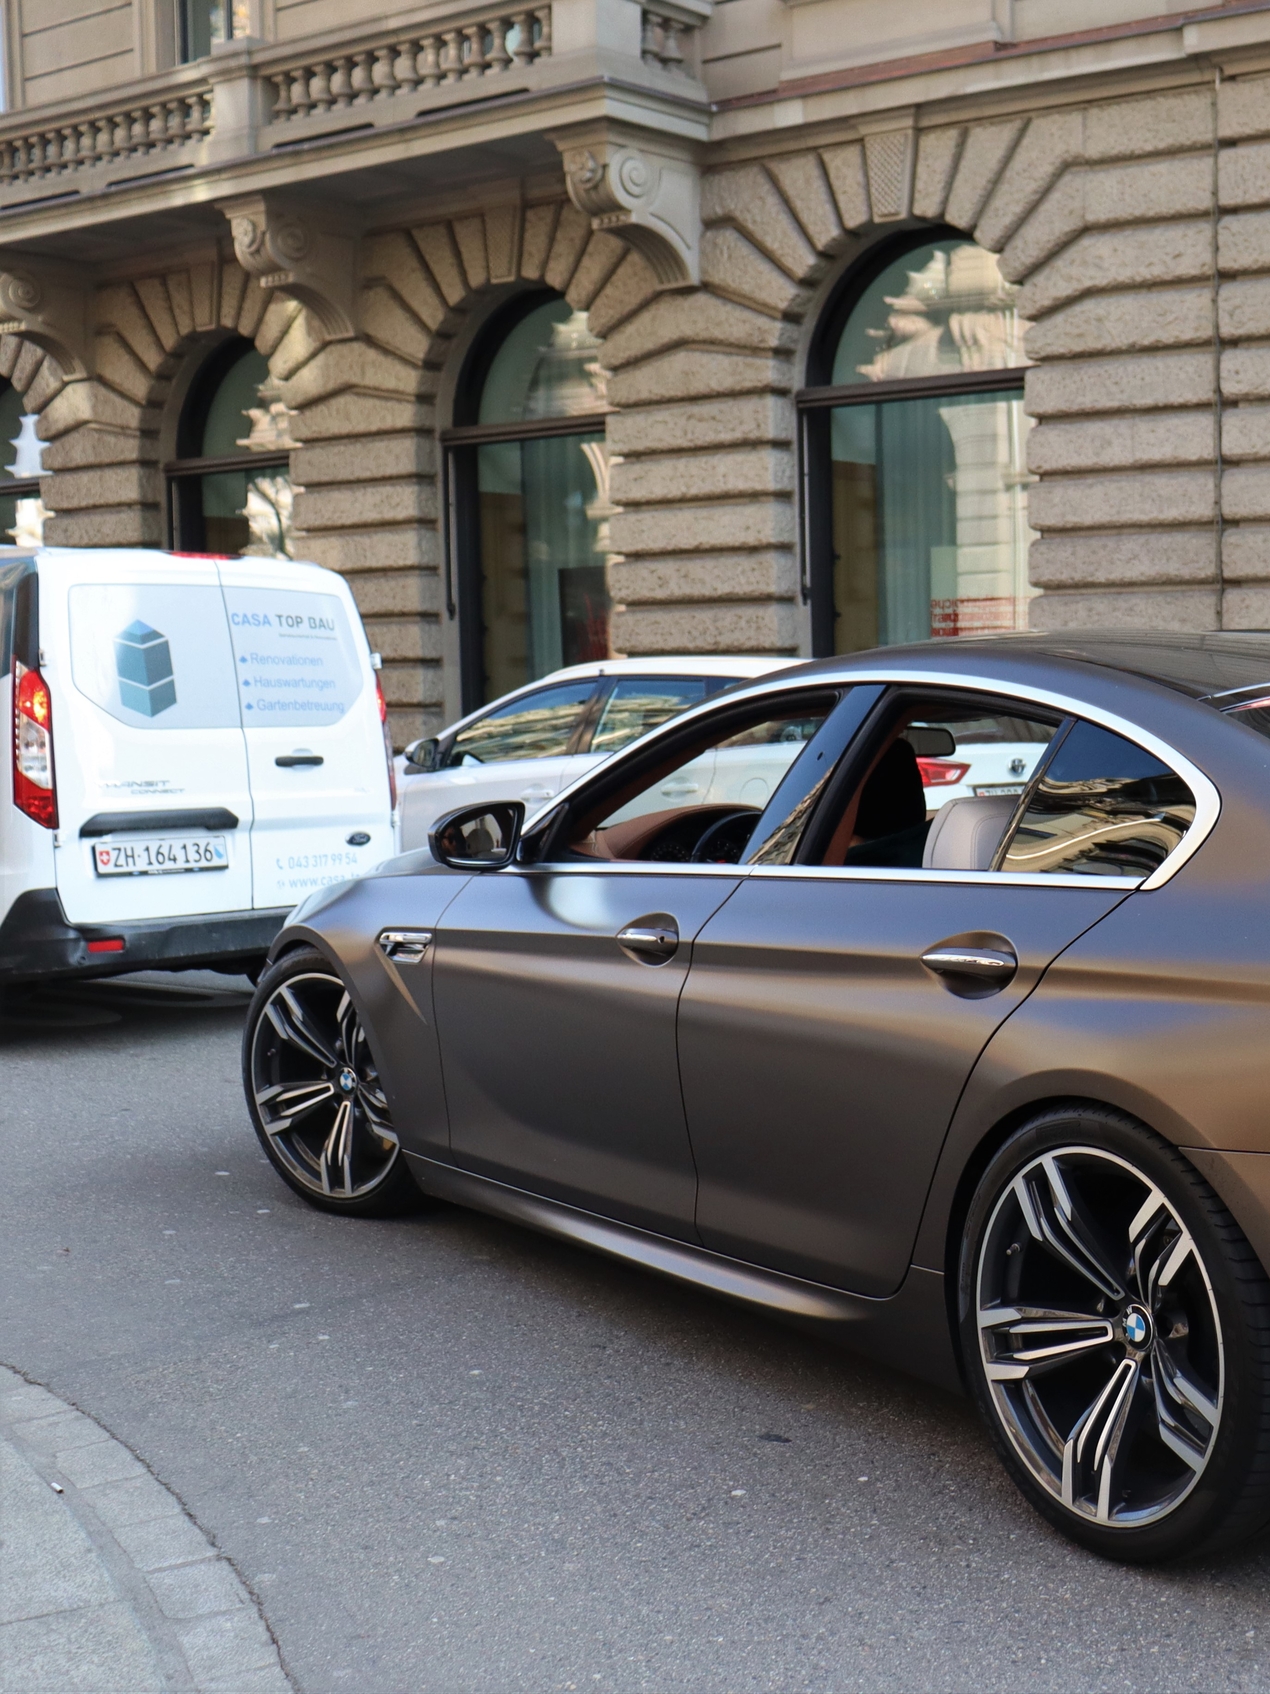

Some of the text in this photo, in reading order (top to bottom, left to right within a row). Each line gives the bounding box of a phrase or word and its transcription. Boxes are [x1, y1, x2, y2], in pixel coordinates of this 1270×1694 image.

[231, 613, 335, 631] CASA TOP BAU
[250, 652, 323, 666] Renovationen
[253, 676, 336, 691] Hauswartungen
[257, 699, 345, 714] Gartenbetreuung
[288, 855, 309, 869] 043
[312, 854, 328, 868] 317
[331, 853, 343, 866] 99
